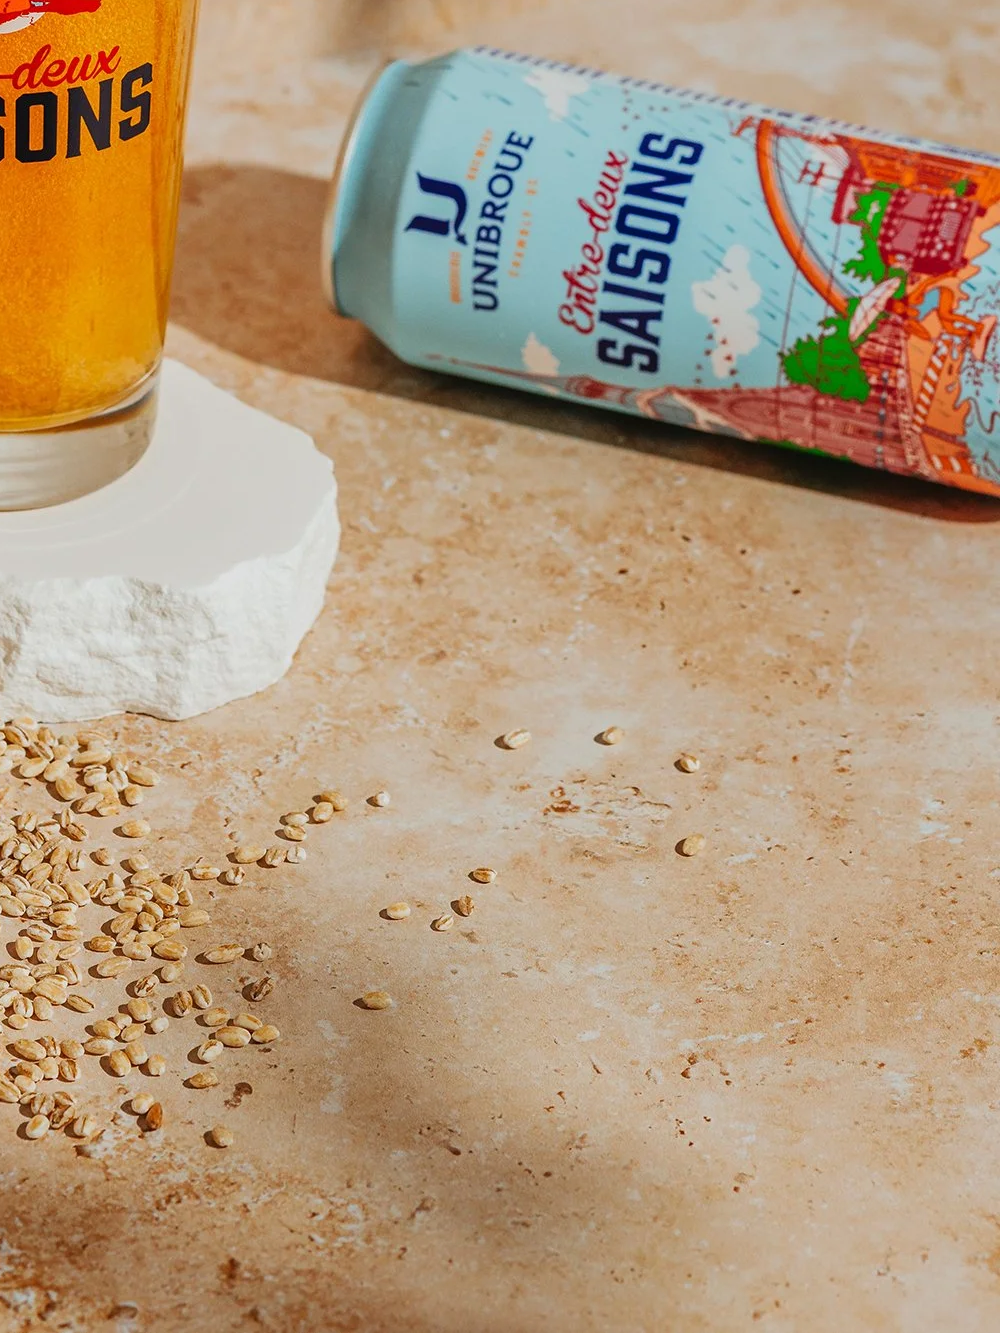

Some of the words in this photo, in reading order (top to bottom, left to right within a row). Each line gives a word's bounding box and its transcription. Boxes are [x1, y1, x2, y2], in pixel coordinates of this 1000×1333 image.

[472, 131, 534, 311] UNIBROUE
[558, 151, 629, 335] Entre-deux
[597, 132, 704, 374] SAISONS
